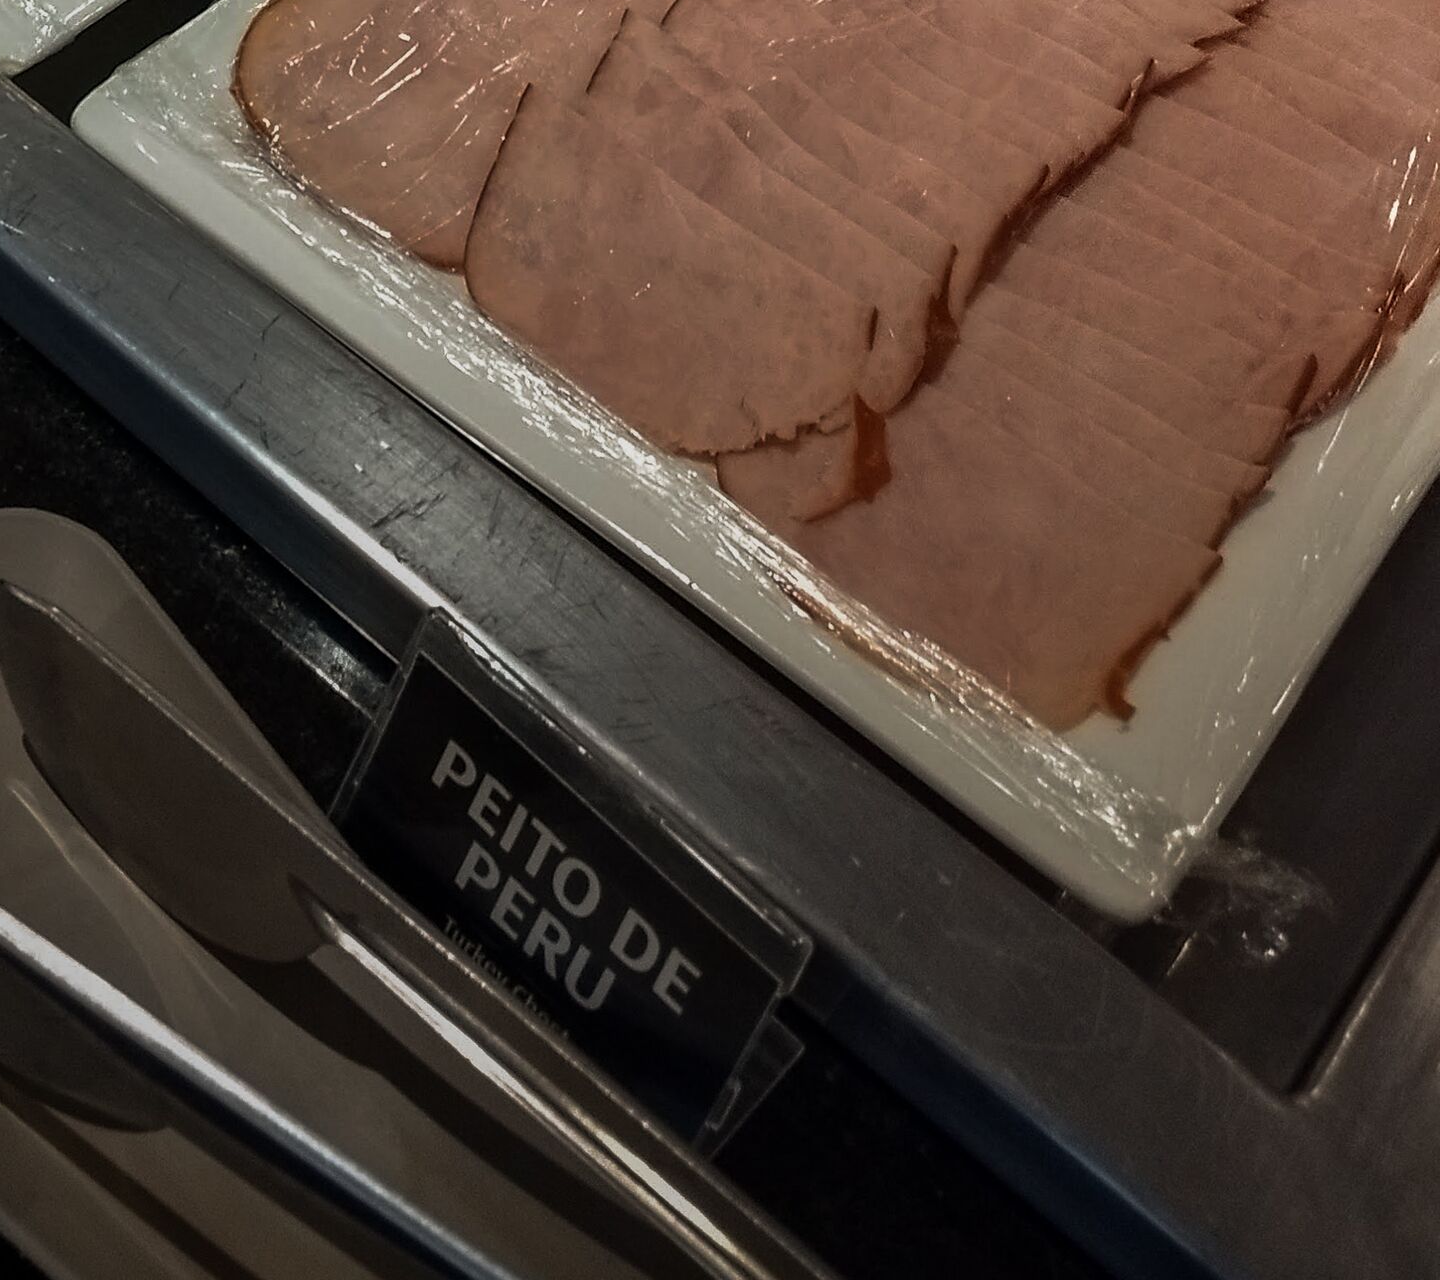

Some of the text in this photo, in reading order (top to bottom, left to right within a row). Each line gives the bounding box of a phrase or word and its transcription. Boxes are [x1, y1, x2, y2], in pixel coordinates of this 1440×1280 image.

[431, 740, 702, 1016] PEITO DE
[454, 840, 616, 1012] PERU
